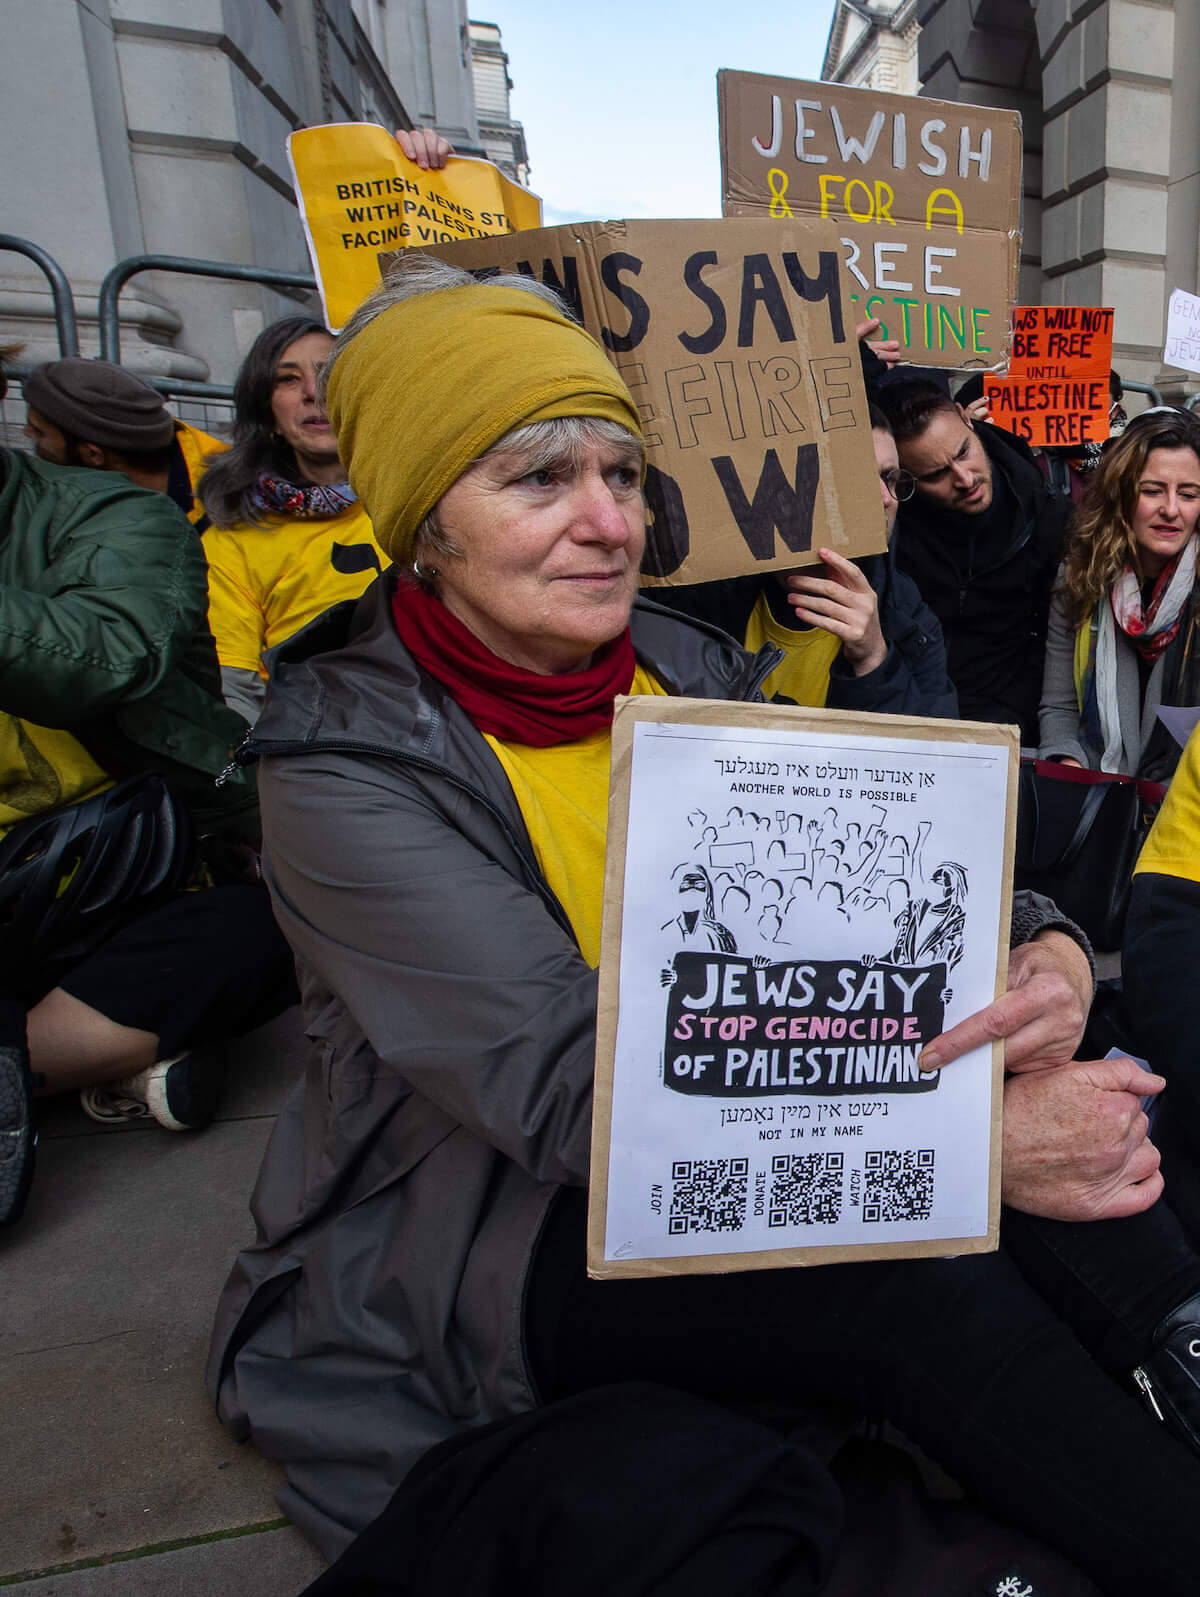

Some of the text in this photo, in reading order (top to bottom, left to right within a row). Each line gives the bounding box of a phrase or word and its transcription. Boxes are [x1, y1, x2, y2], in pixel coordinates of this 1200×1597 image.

[752, 95, 992, 182] JEWISH
[336, 177, 420, 200] BRITISH
[426, 191, 475, 221] JEWS
[345, 204, 400, 224] WITH
[766, 168, 964, 235] & FOR A
[341, 223, 411, 250] FACING
[676, 250, 846, 355] SAY
[850, 294, 993, 353] STINE
[1043, 307, 1079, 330] WILL
[1080, 310, 1114, 335] NOT
[1013, 332, 1095, 359] BE FREE
[1026, 365, 1072, 379] UNTIL
[987, 383, 1104, 412] PALESTINE
[1011, 413, 1094, 444] IS FREE
[730, 782, 918, 803] ANOTHER WORLD IS POSSIBLE
[681, 963, 931, 1014] JEWS SAY
[673, 1013, 921, 1041] STOP GENOCIDE
[759, 1125, 864, 1141] NOT IN MY NAME
[654, 1184, 664, 1216] JOIN
[753, 1170, 767, 1217] DONATE
[849, 1168, 862, 1207] WATCH
